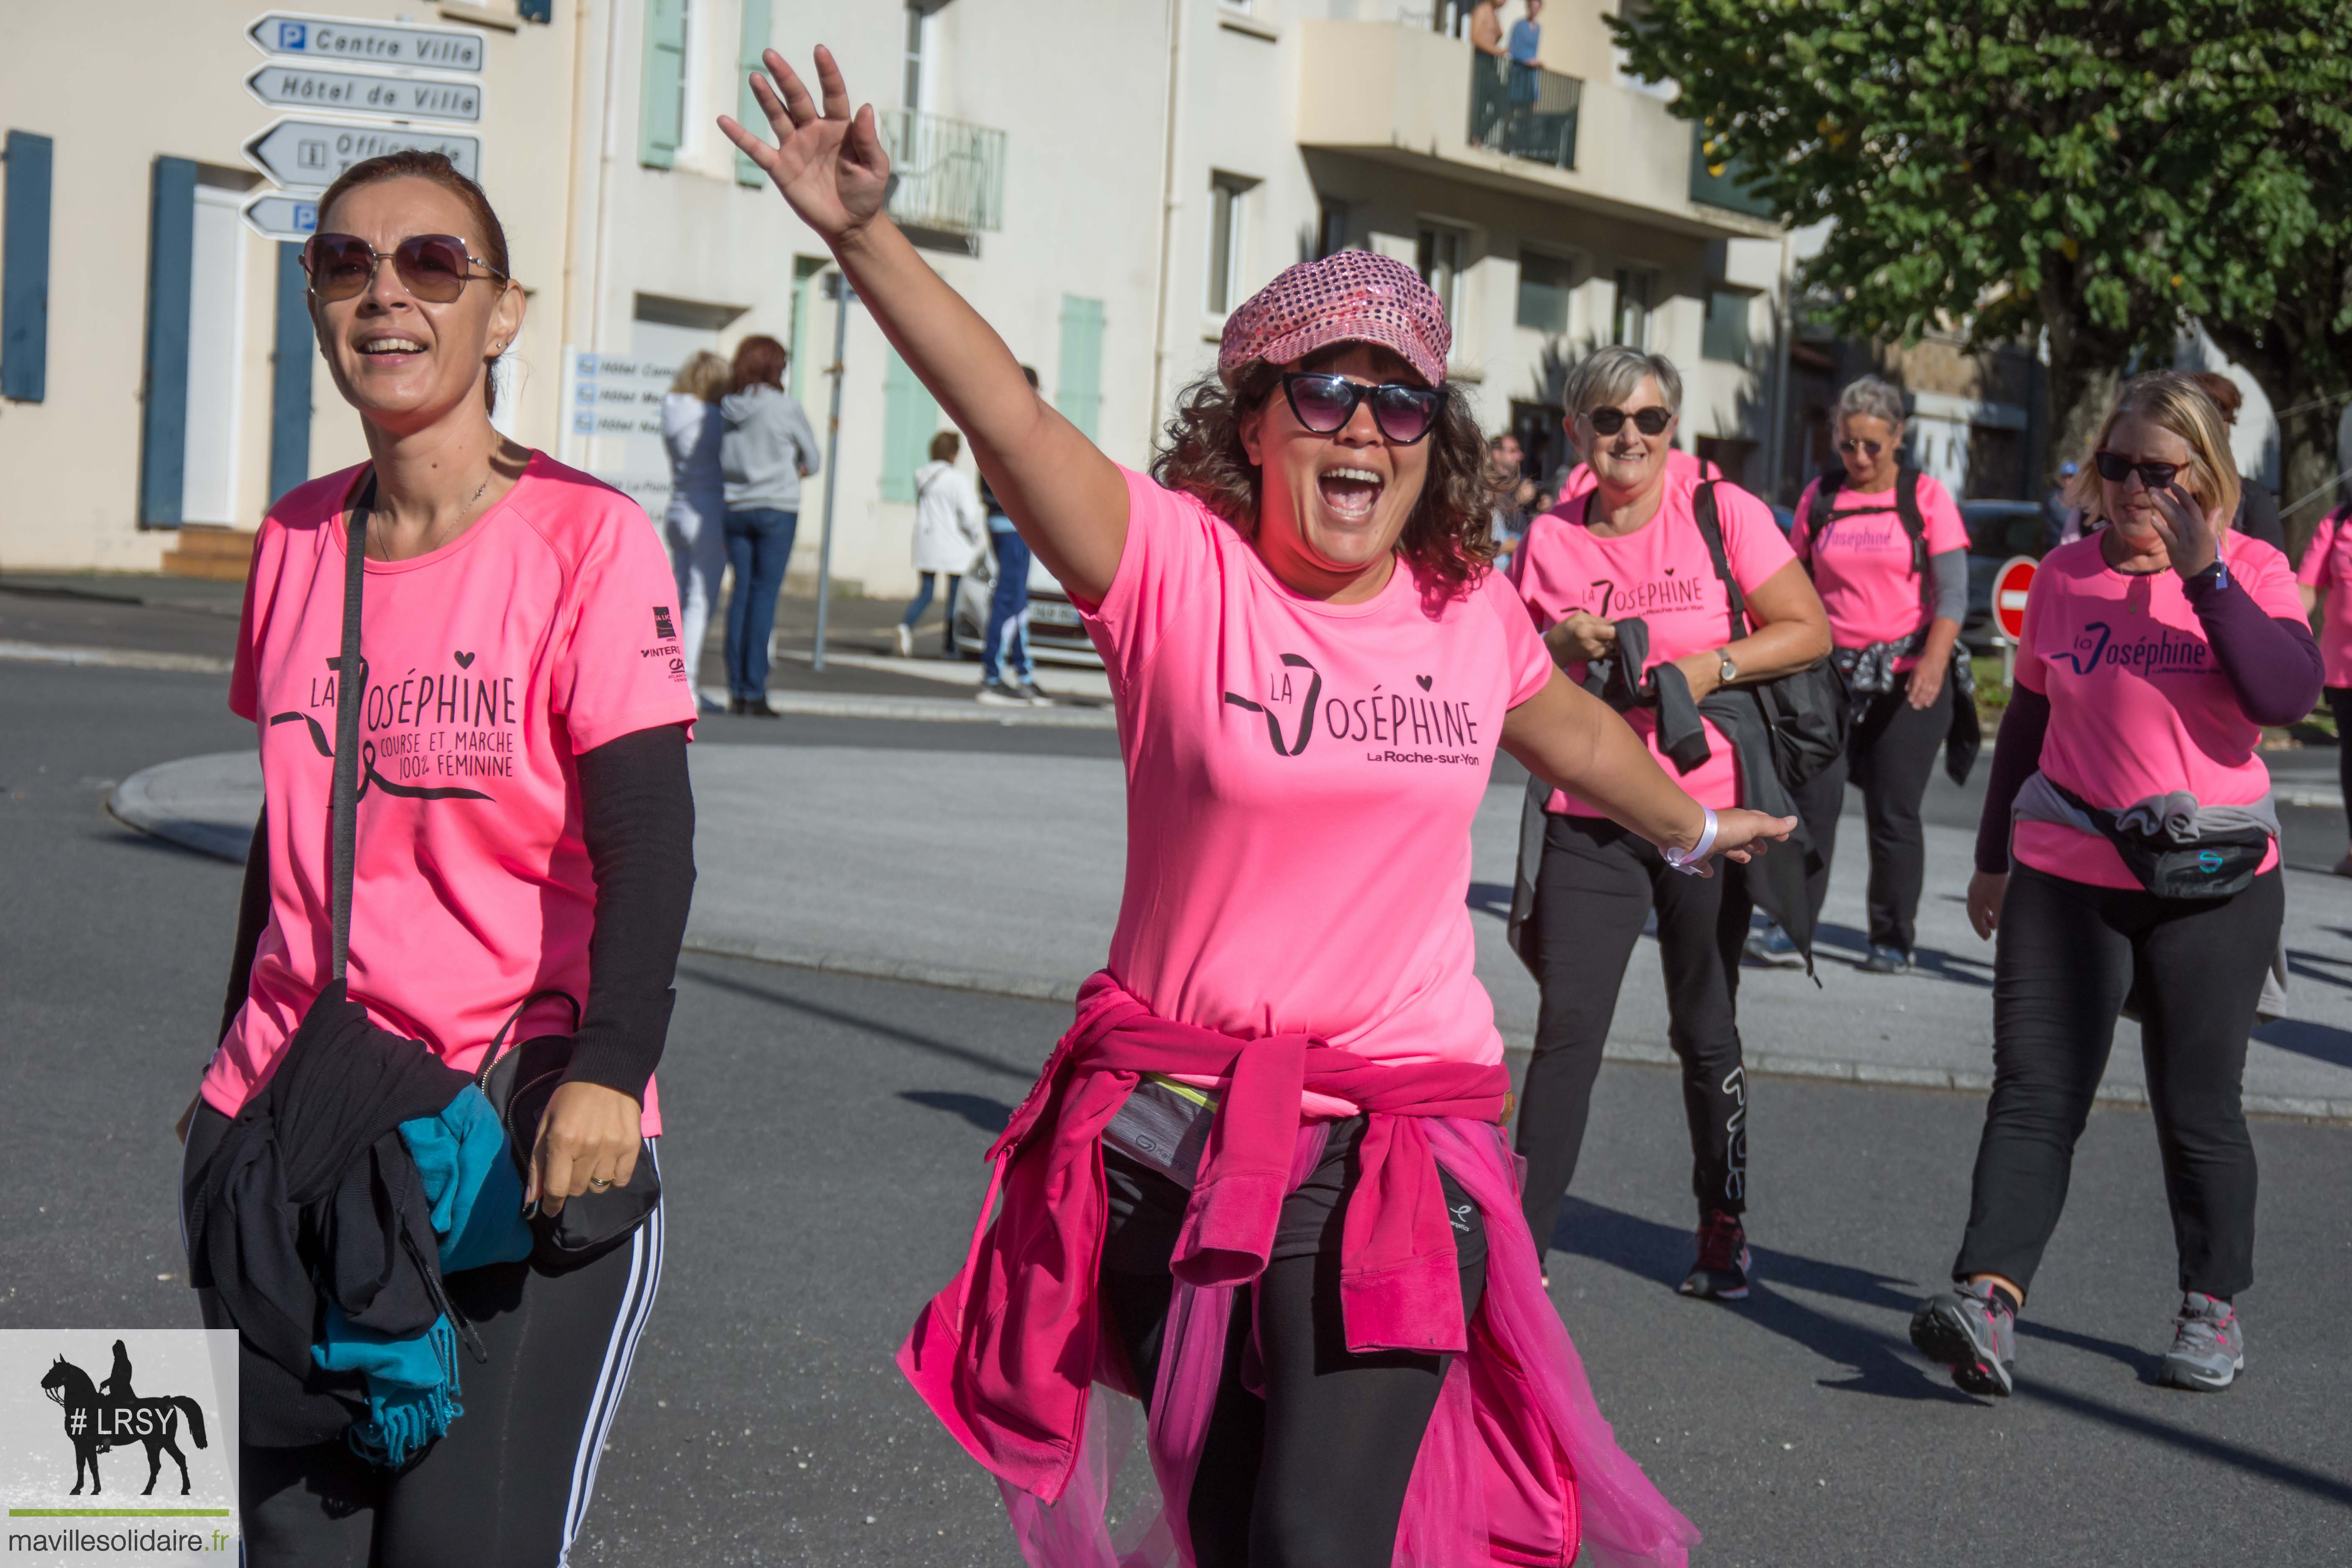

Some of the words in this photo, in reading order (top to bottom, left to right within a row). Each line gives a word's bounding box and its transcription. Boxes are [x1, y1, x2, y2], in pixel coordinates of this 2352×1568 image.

[316, 28, 401, 56] Centre
[417, 40, 473, 63] Ville
[281, 75, 352, 102] Hôtel
[368, 85, 396, 105] de
[414, 89, 473, 111] Ville
[311, 676, 335, 708] LA
[1270, 673, 1292, 704] LA
[380, 733, 421, 757] COURSE
[429, 731, 445, 751] ET
[455, 731, 513, 752] MARCHE
[1367, 752, 1382, 762] La
[1384, 751, 1479, 766] Roche-sur-Yon
[399, 755, 430, 780] 100%
[438, 750, 513, 777] FÉMININE
